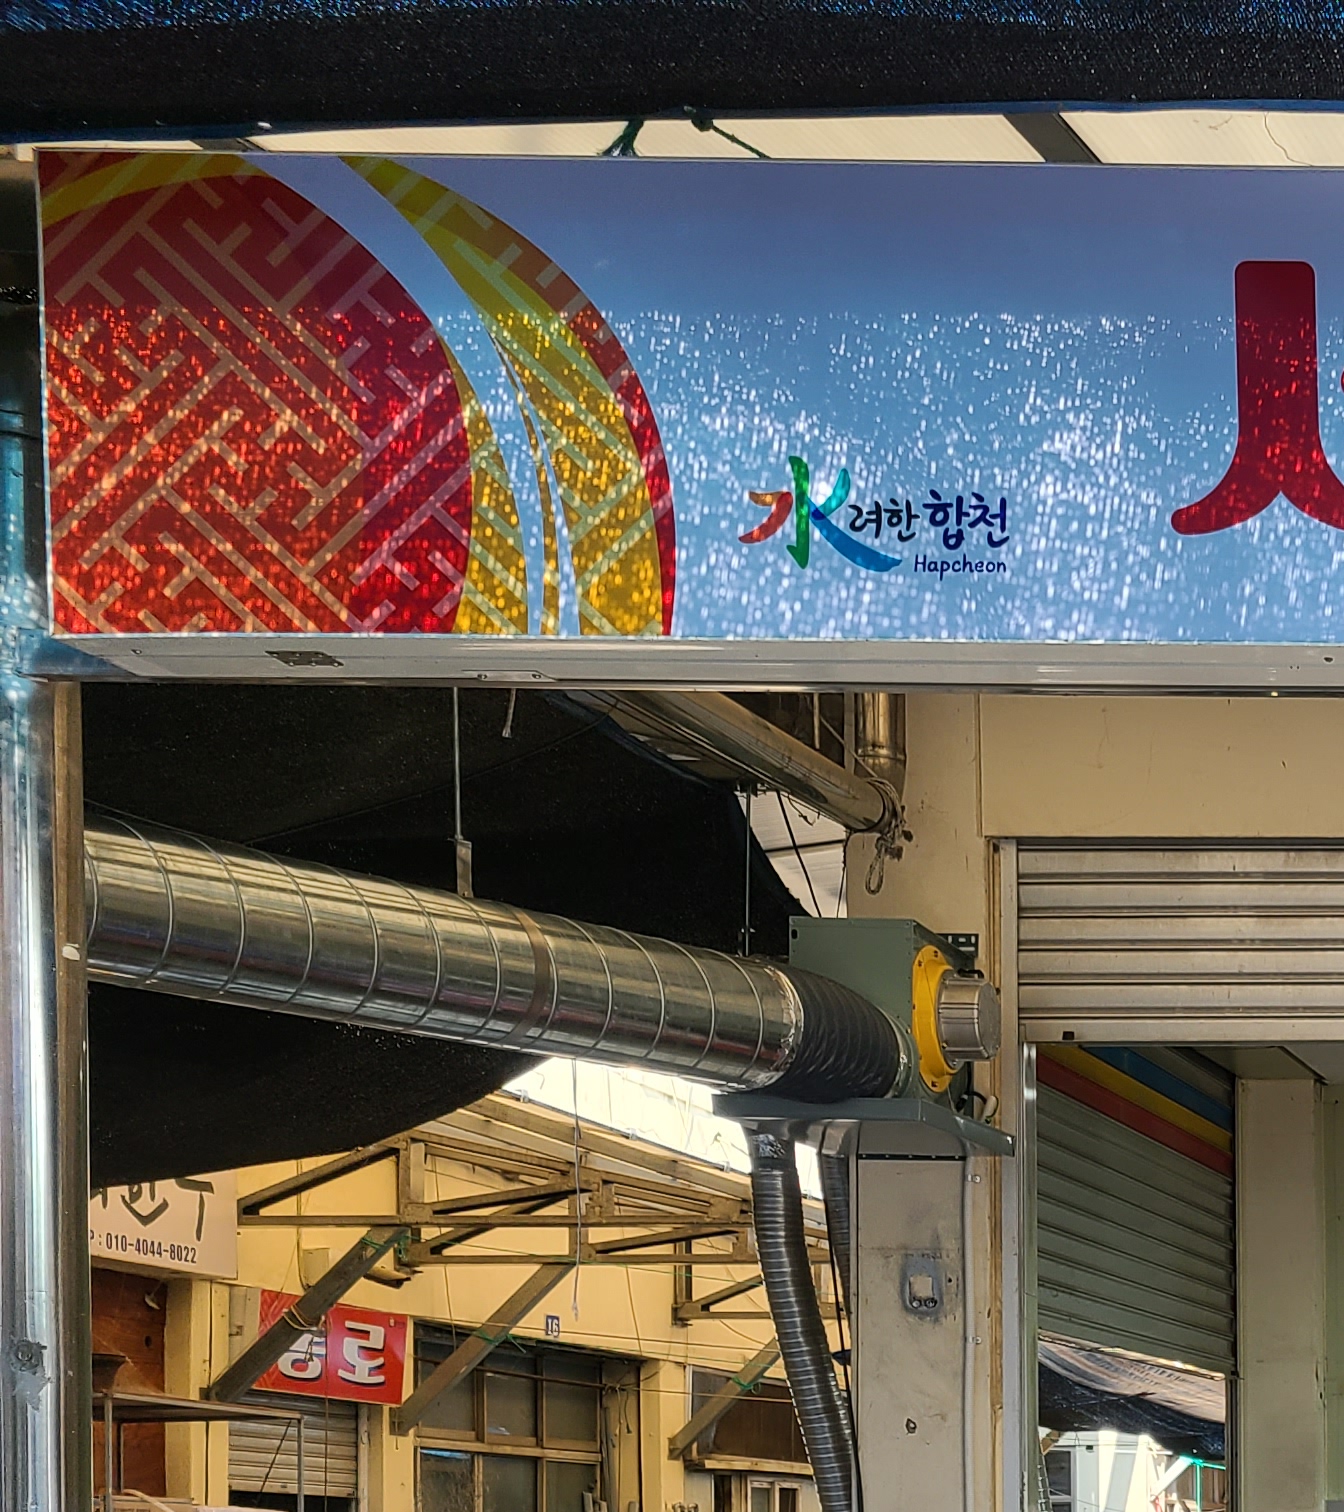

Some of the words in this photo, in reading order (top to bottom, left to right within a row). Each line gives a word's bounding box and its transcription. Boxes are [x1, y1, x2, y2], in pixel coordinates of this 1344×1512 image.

[922, 488, 1010, 550] 합천
[913, 554, 1007, 582] Hapcheon
[105, 1232, 198, 1264] 010-4044-8022
